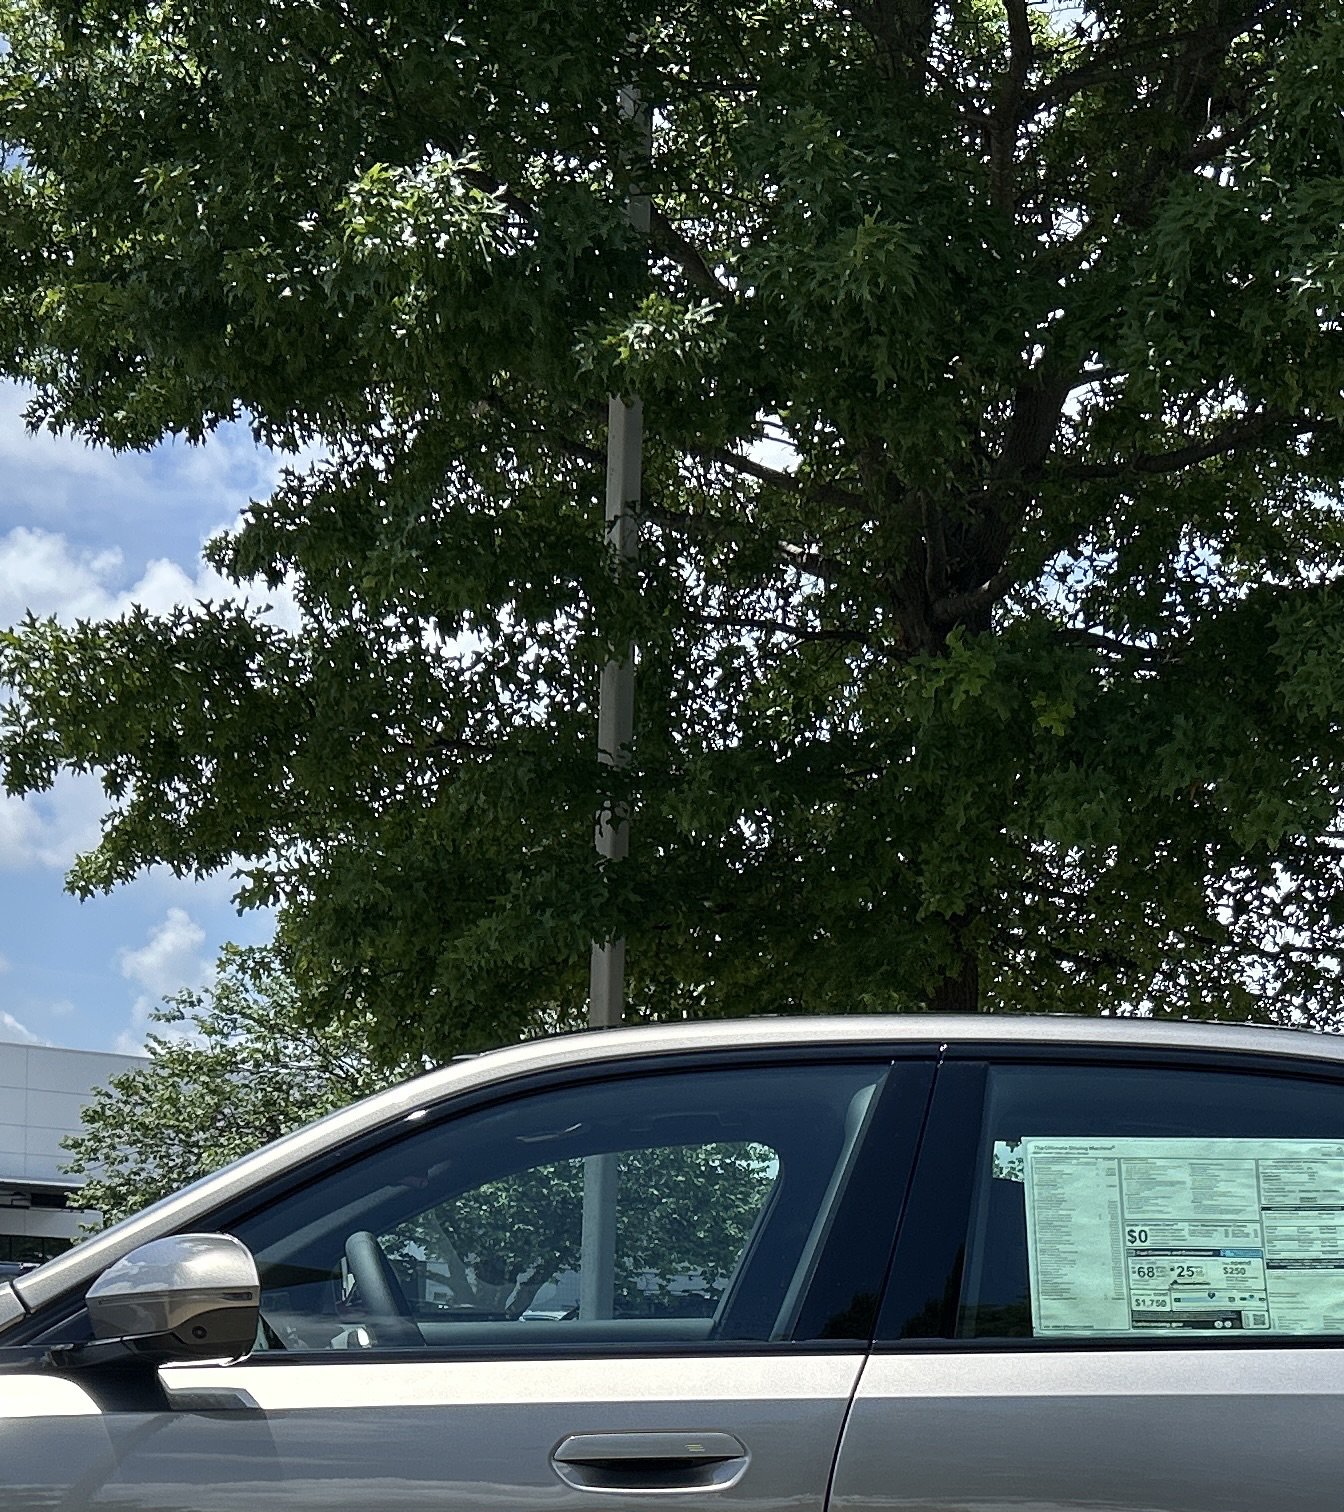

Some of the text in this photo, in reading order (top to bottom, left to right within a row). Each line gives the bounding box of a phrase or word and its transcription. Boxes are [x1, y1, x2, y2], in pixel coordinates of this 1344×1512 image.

[1127, 1229, 1148, 1244] $0
[1137, 1266, 1155, 1278] 68
[1176, 1265, 1195, 1278] 25
[1223, 1267, 1246, 1275] $250
[1134, 1298, 1167, 1308] $1,750
